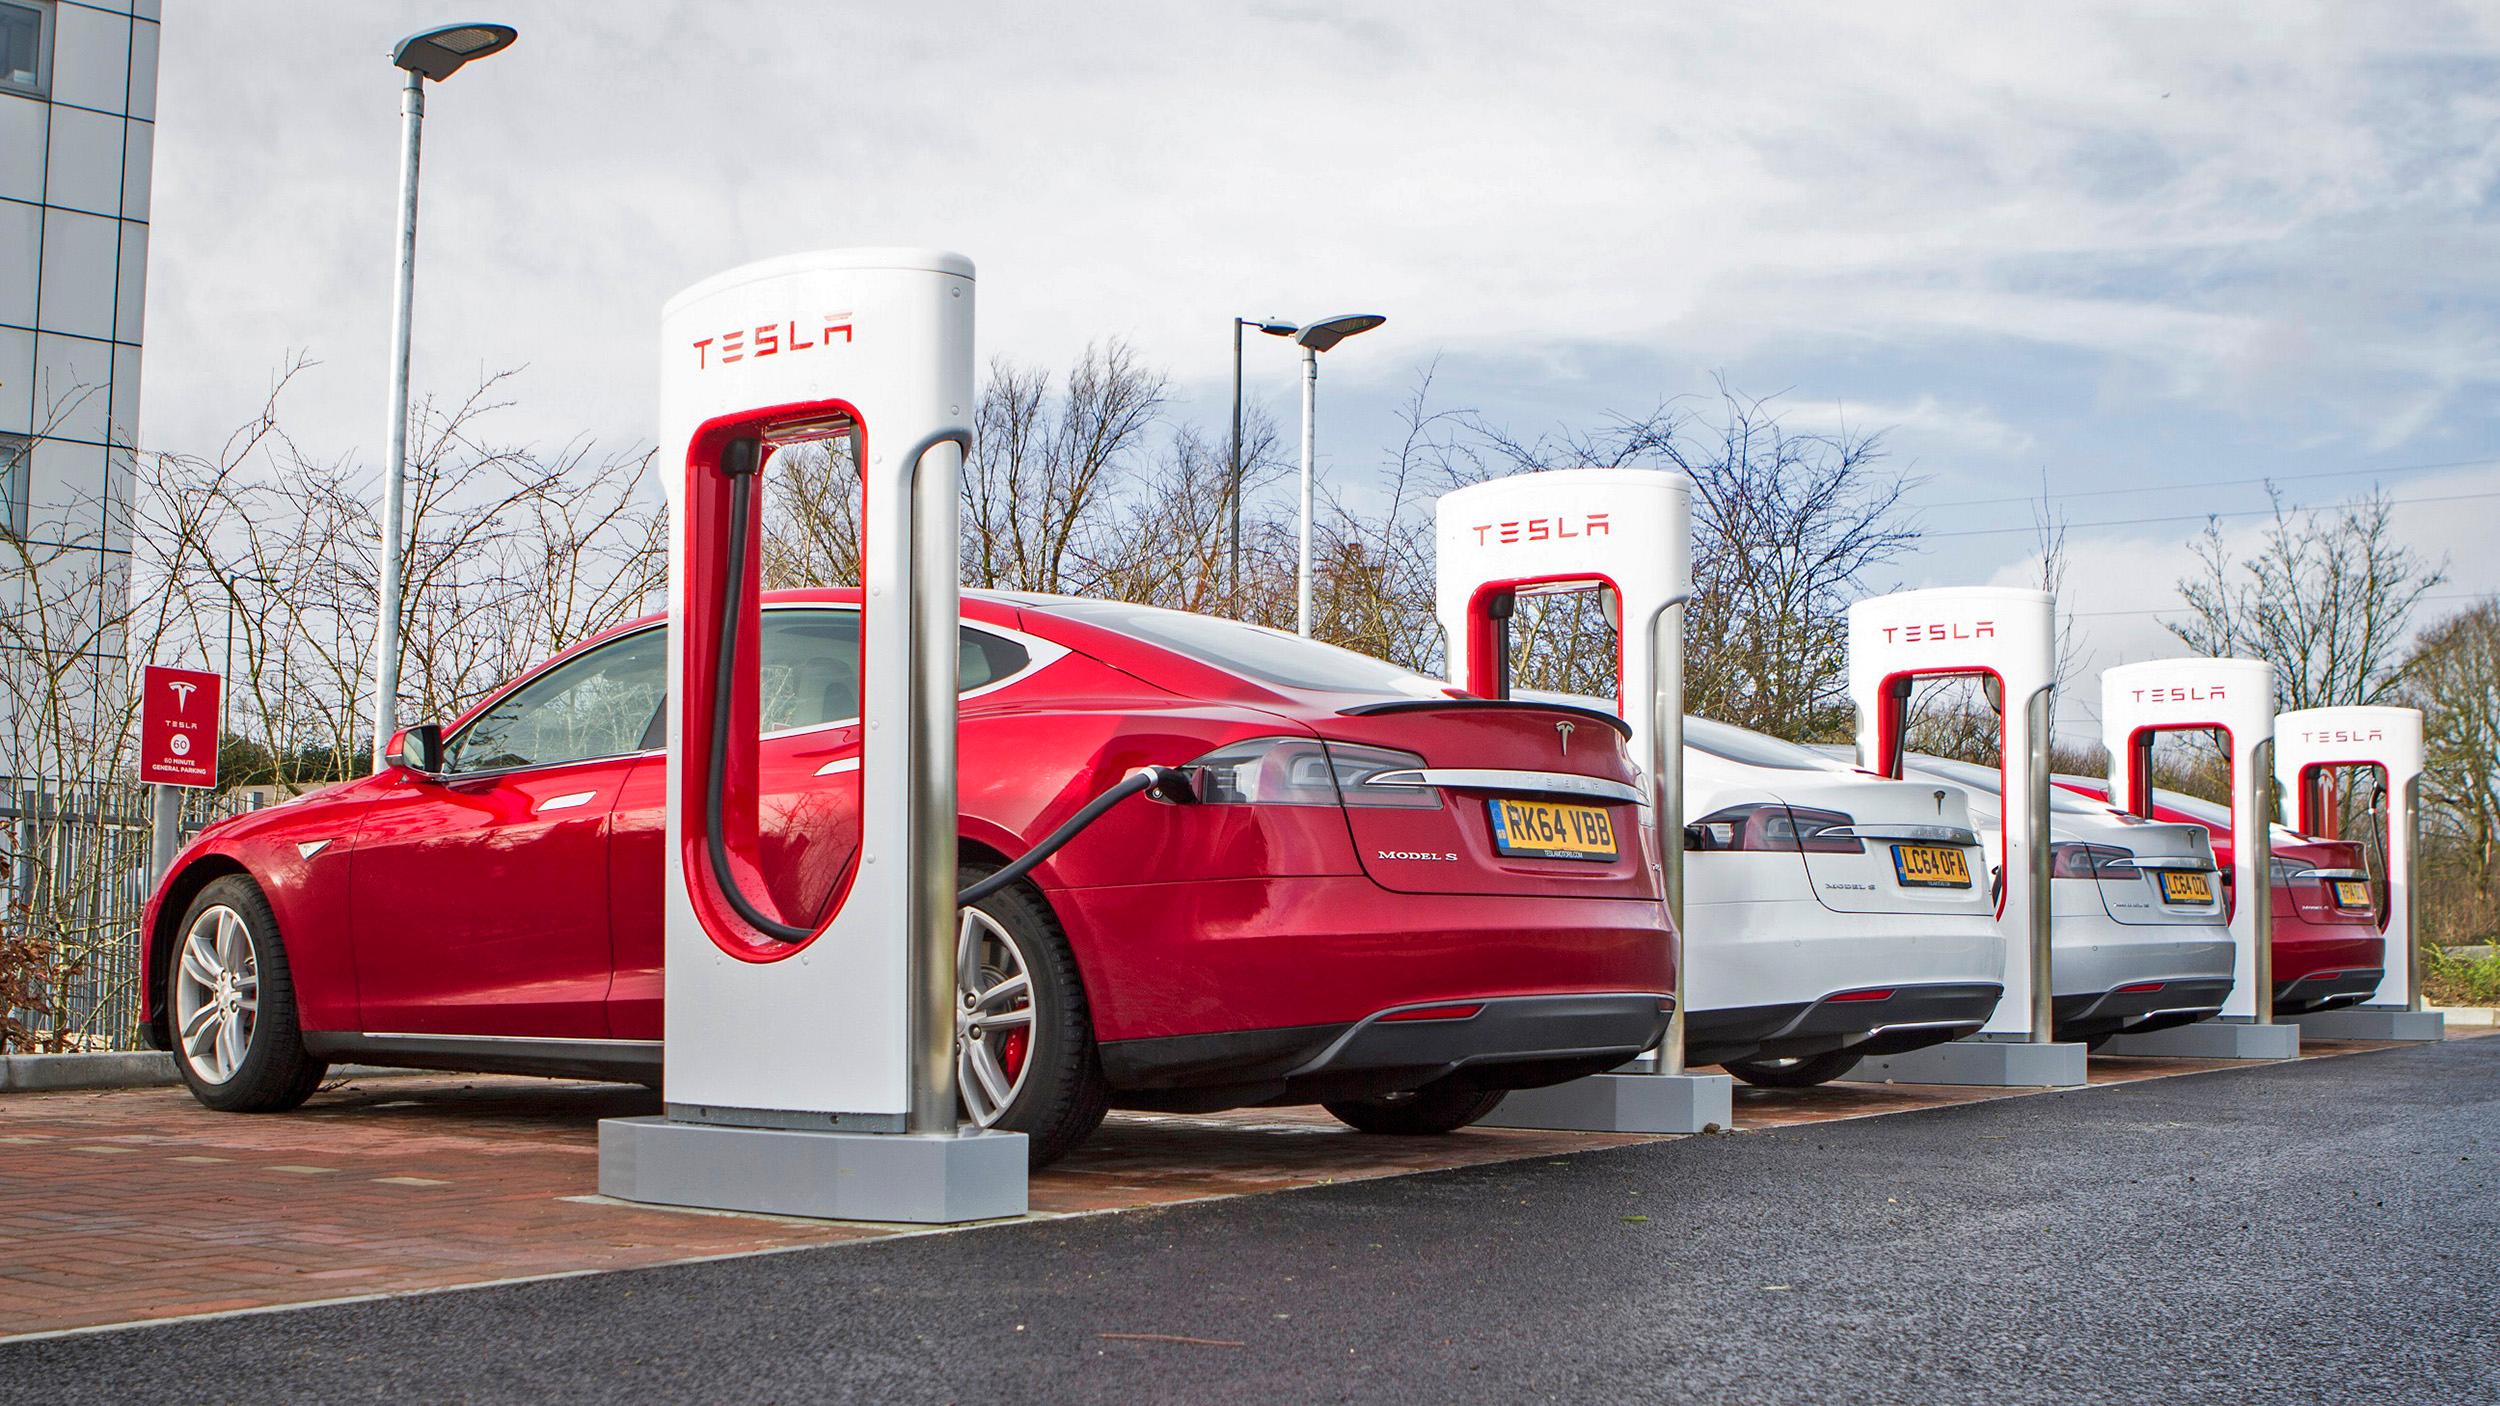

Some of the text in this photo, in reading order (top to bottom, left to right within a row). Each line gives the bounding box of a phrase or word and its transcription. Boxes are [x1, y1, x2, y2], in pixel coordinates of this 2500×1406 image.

[693, 311, 853, 370] TESLA
[1472, 513, 1609, 546] TESLA
[1882, 621, 1994, 644] TESLA
[2131, 685, 2225, 703] TESLA
[165, 719, 198, 730] TESLA
[173, 739, 187, 749] 60
[2301, 729, 2382, 744] TESLA
[152, 764, 206, 775] GENERAL PARKING
[173, 758, 196, 766] MINUTE
[1506, 804, 1611, 846] RK64 VBB
[1378, 850, 1458, 861] MODEL S
[1902, 848, 1967, 876] LC64 OFA
[2166, 874, 2193, 895] LC64
